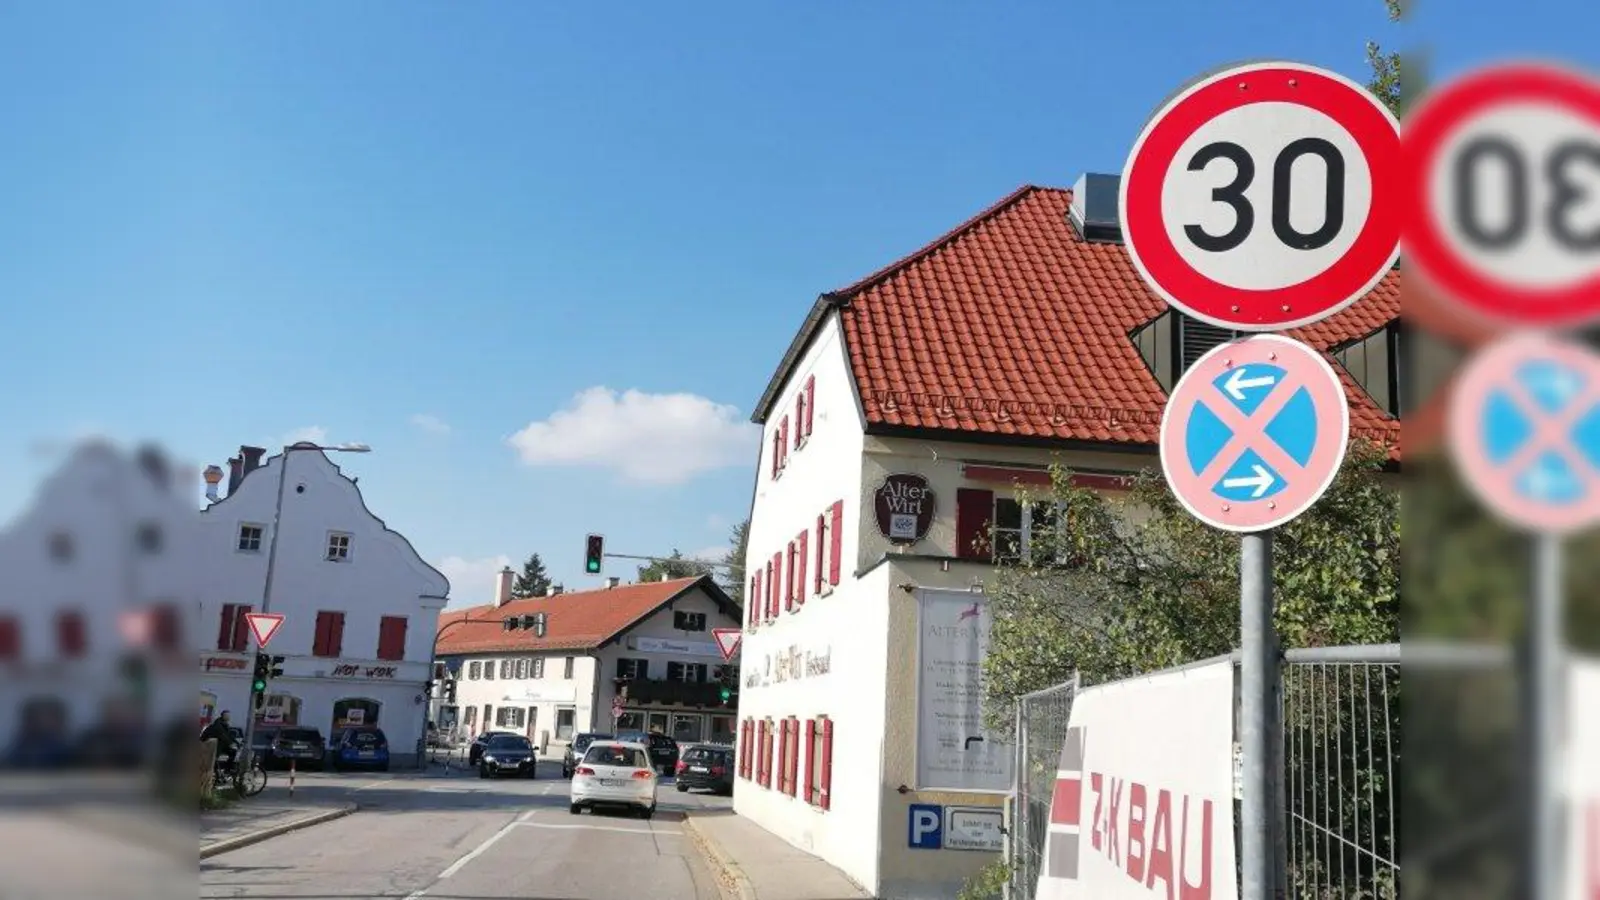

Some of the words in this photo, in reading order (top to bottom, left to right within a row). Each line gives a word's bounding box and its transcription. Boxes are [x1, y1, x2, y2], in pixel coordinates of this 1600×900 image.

[1183, 137, 1345, 252] 30
[880, 481, 929, 500] Alter
[885, 497, 923, 515] Wirt
[928, 624, 969, 638] ALTER
[331, 663, 360, 676] HOT
[365, 665, 398, 678] WOK
[914, 810, 939, 844] P
[1126, 782, 1213, 900] BAU
